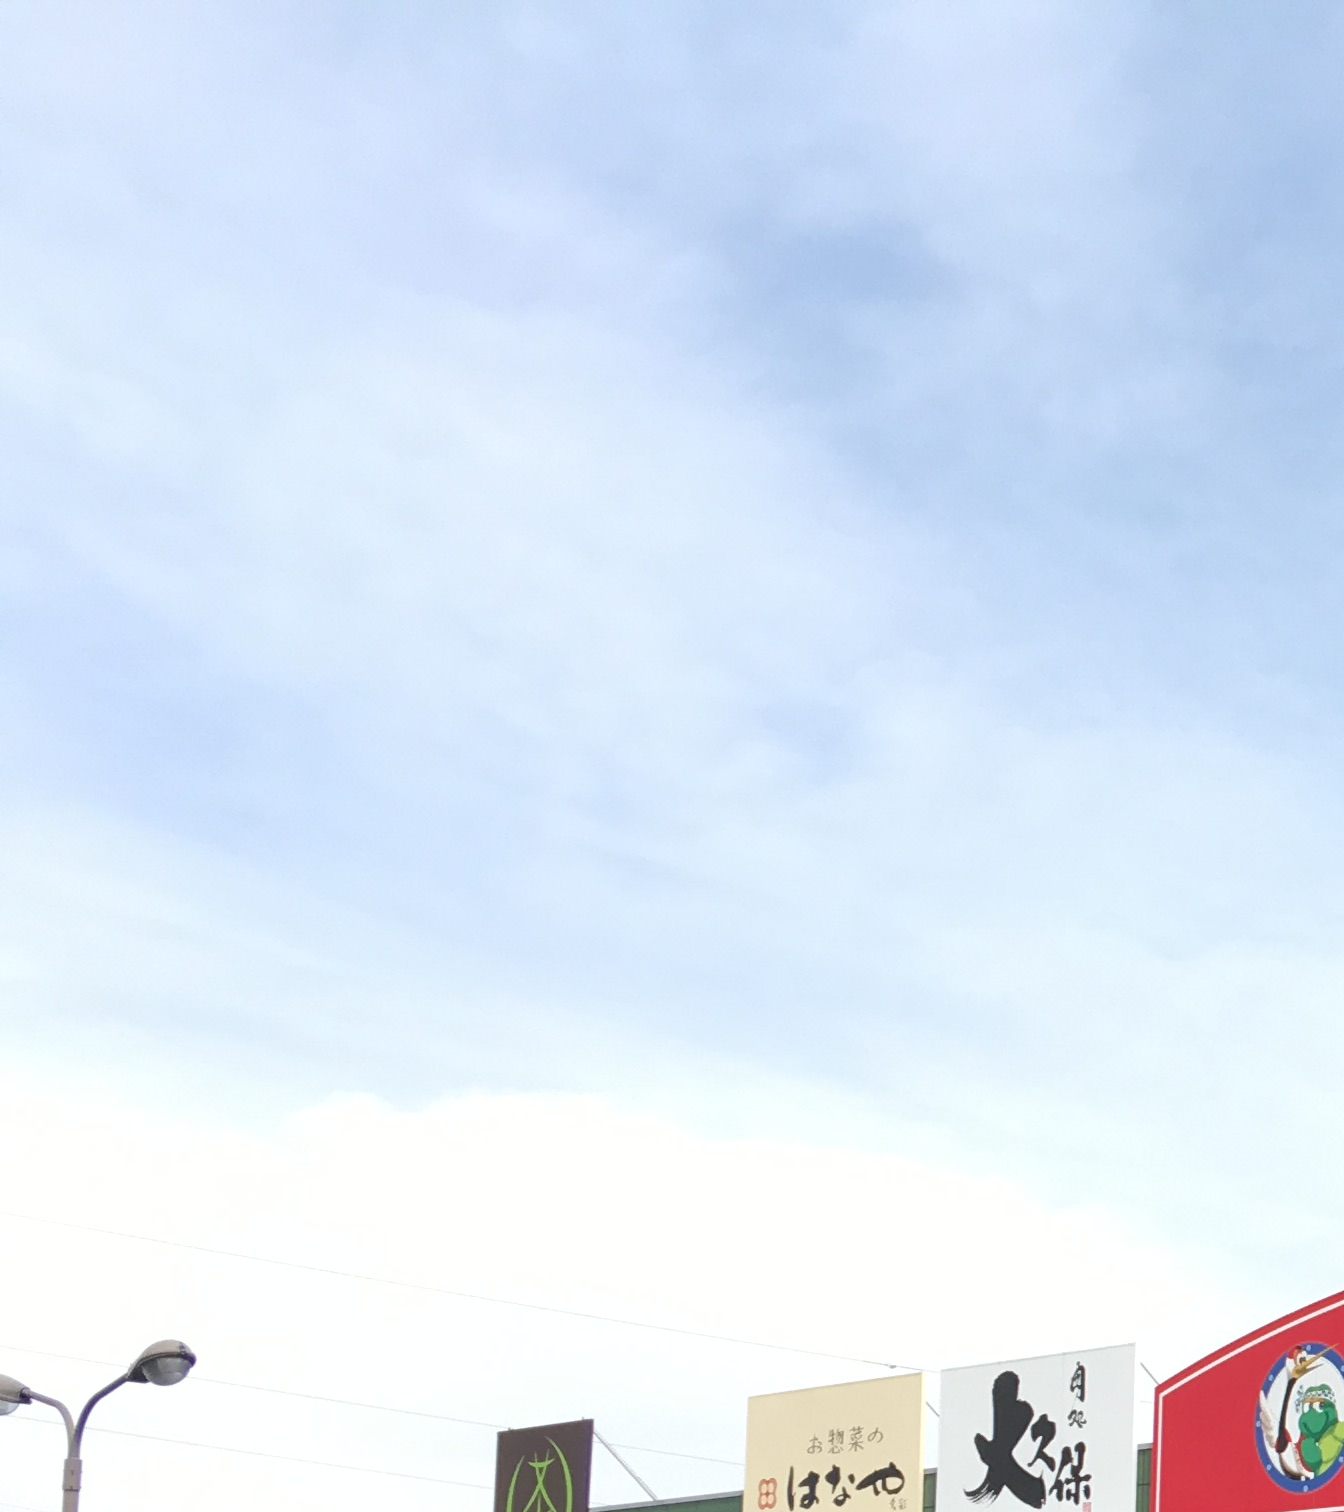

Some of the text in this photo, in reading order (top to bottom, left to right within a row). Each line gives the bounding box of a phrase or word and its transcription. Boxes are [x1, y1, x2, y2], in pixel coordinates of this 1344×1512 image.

[807, 1426, 884, 1454] お惣菜の
[963, 1371, 1092, 1509] 大久保
[787, 1462, 905, 1511] はなや
